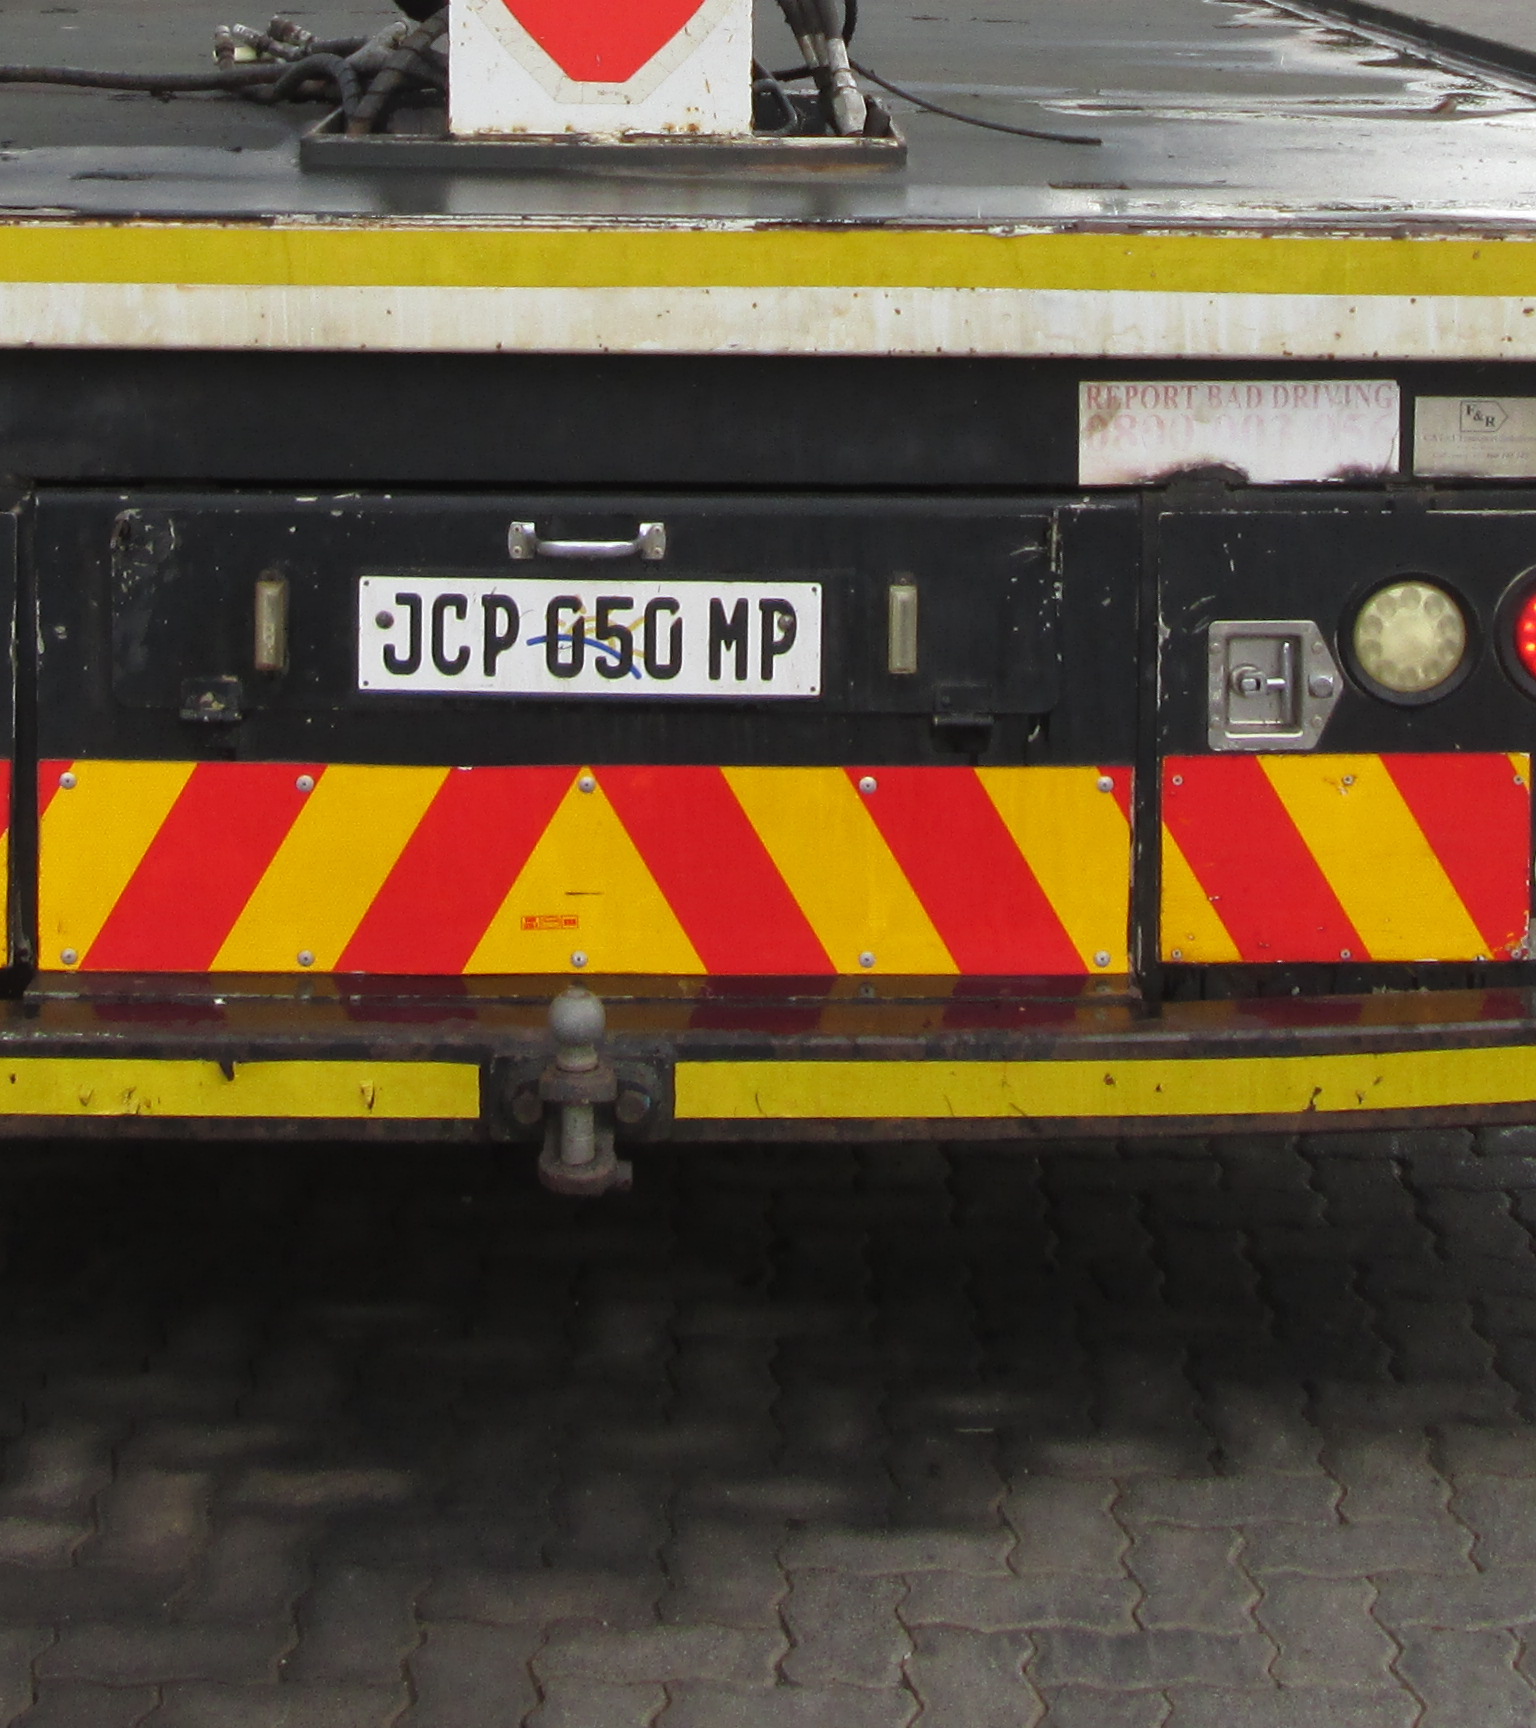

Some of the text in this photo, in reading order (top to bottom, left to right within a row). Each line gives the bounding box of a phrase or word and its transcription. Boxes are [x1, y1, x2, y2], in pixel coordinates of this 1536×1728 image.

[1086, 383, 1394, 410] REPORT BAD DRIVING
[1465, 404, 1496, 427] F&R
[383, 592, 798, 682] JCP 050 MP
